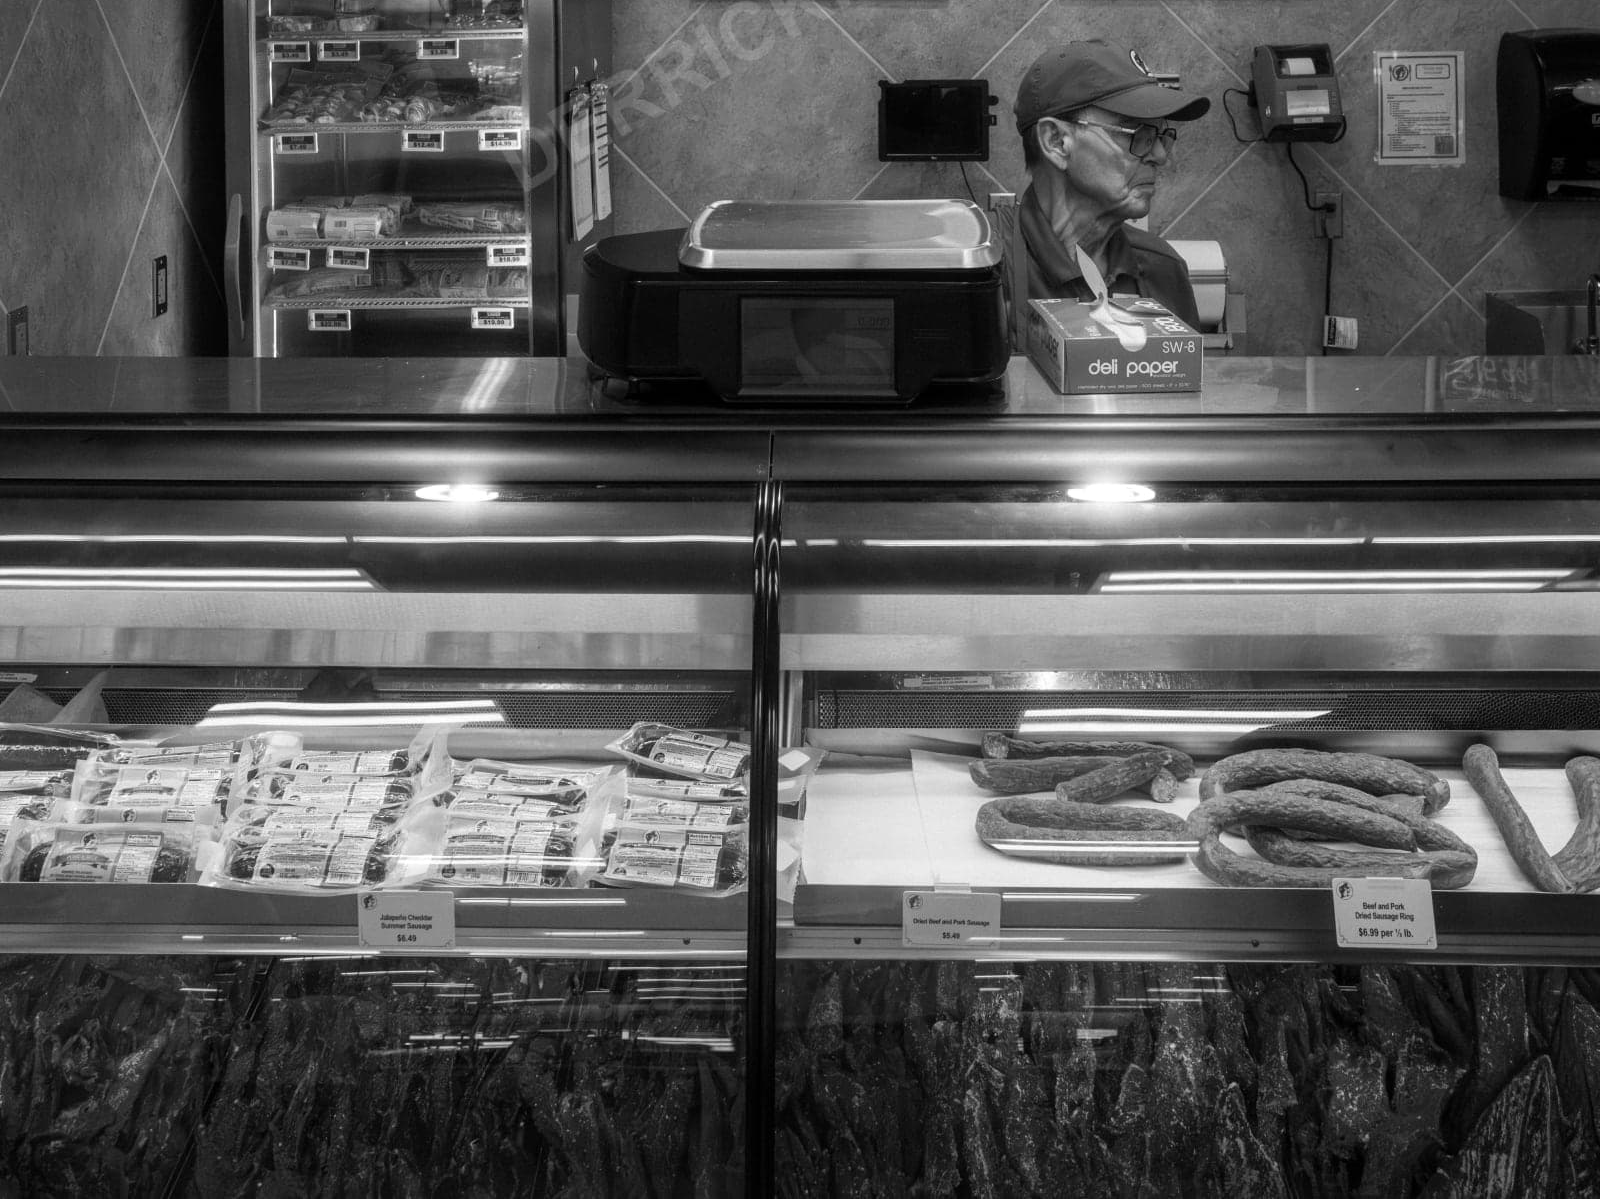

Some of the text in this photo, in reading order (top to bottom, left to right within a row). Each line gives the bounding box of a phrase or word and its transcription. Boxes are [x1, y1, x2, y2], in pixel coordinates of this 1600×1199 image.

[1162, 340, 1196, 354] SW-8
[1088, 359, 1179, 378] deli paper
[1363, 902, 1405, 910] Beef and Pork
[1355, 911, 1415, 922] Dried Sausage Ring
[407, 922, 433, 930] Sausage
[967, 919, 990, 927] Sausage
[397, 933, 417, 942] $6.49
[942, 931, 961, 939] $5.49
[1358, 927, 1379, 937] $6.99
[1381, 930, 1394, 939] per
[1404, 928, 1414, 937] lb.
